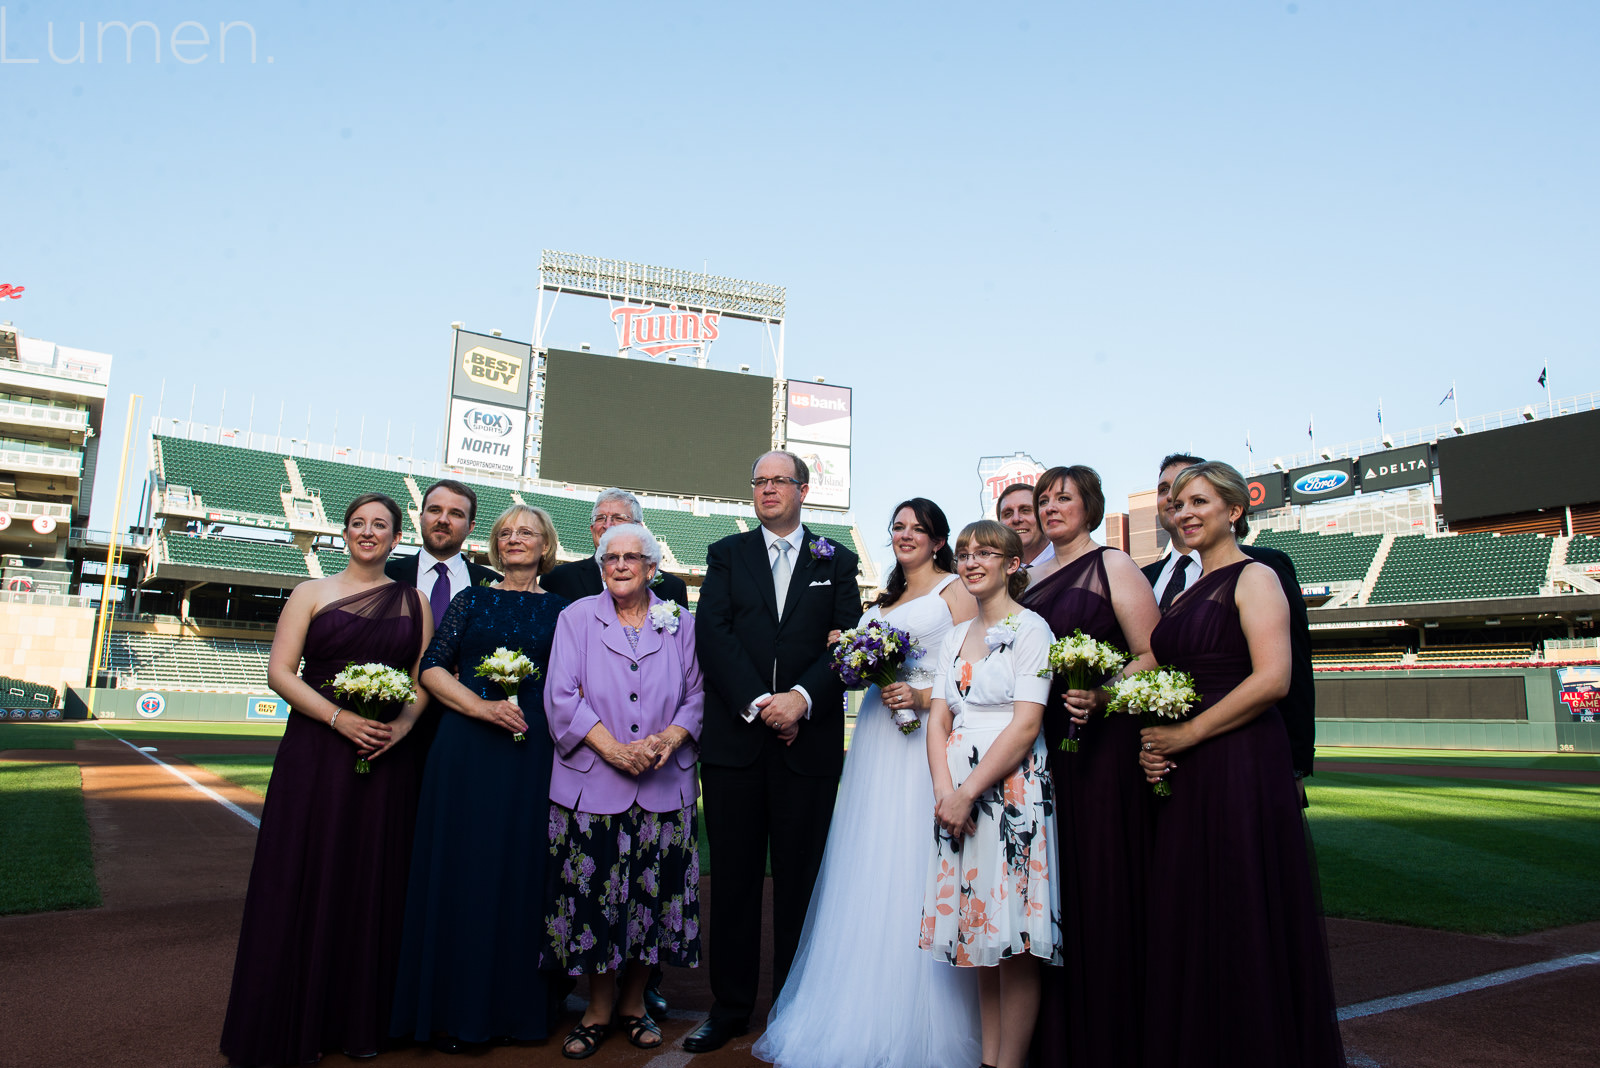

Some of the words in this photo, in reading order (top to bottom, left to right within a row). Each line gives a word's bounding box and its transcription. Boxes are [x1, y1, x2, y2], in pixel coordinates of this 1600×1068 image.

[610, 303, 719, 348] Twins
[471, 352, 520, 375] BEST
[471, 364, 515, 385] BUY
[473, 411, 502, 428] FOX
[473, 424, 503, 434] SPORTS
[461, 437, 511, 457] NORTH
[457, 457, 514, 472] FOXSPORTSNORTH.COM
[1379, 459, 1427, 476] DELTA
[1304, 473, 1338, 491] Ford
[42, 520, 48, 528] 3
[1572, 700, 1600, 708] GAME
[1583, 692, 1600, 700] STA
[1581, 715, 1596, 723] FOX
